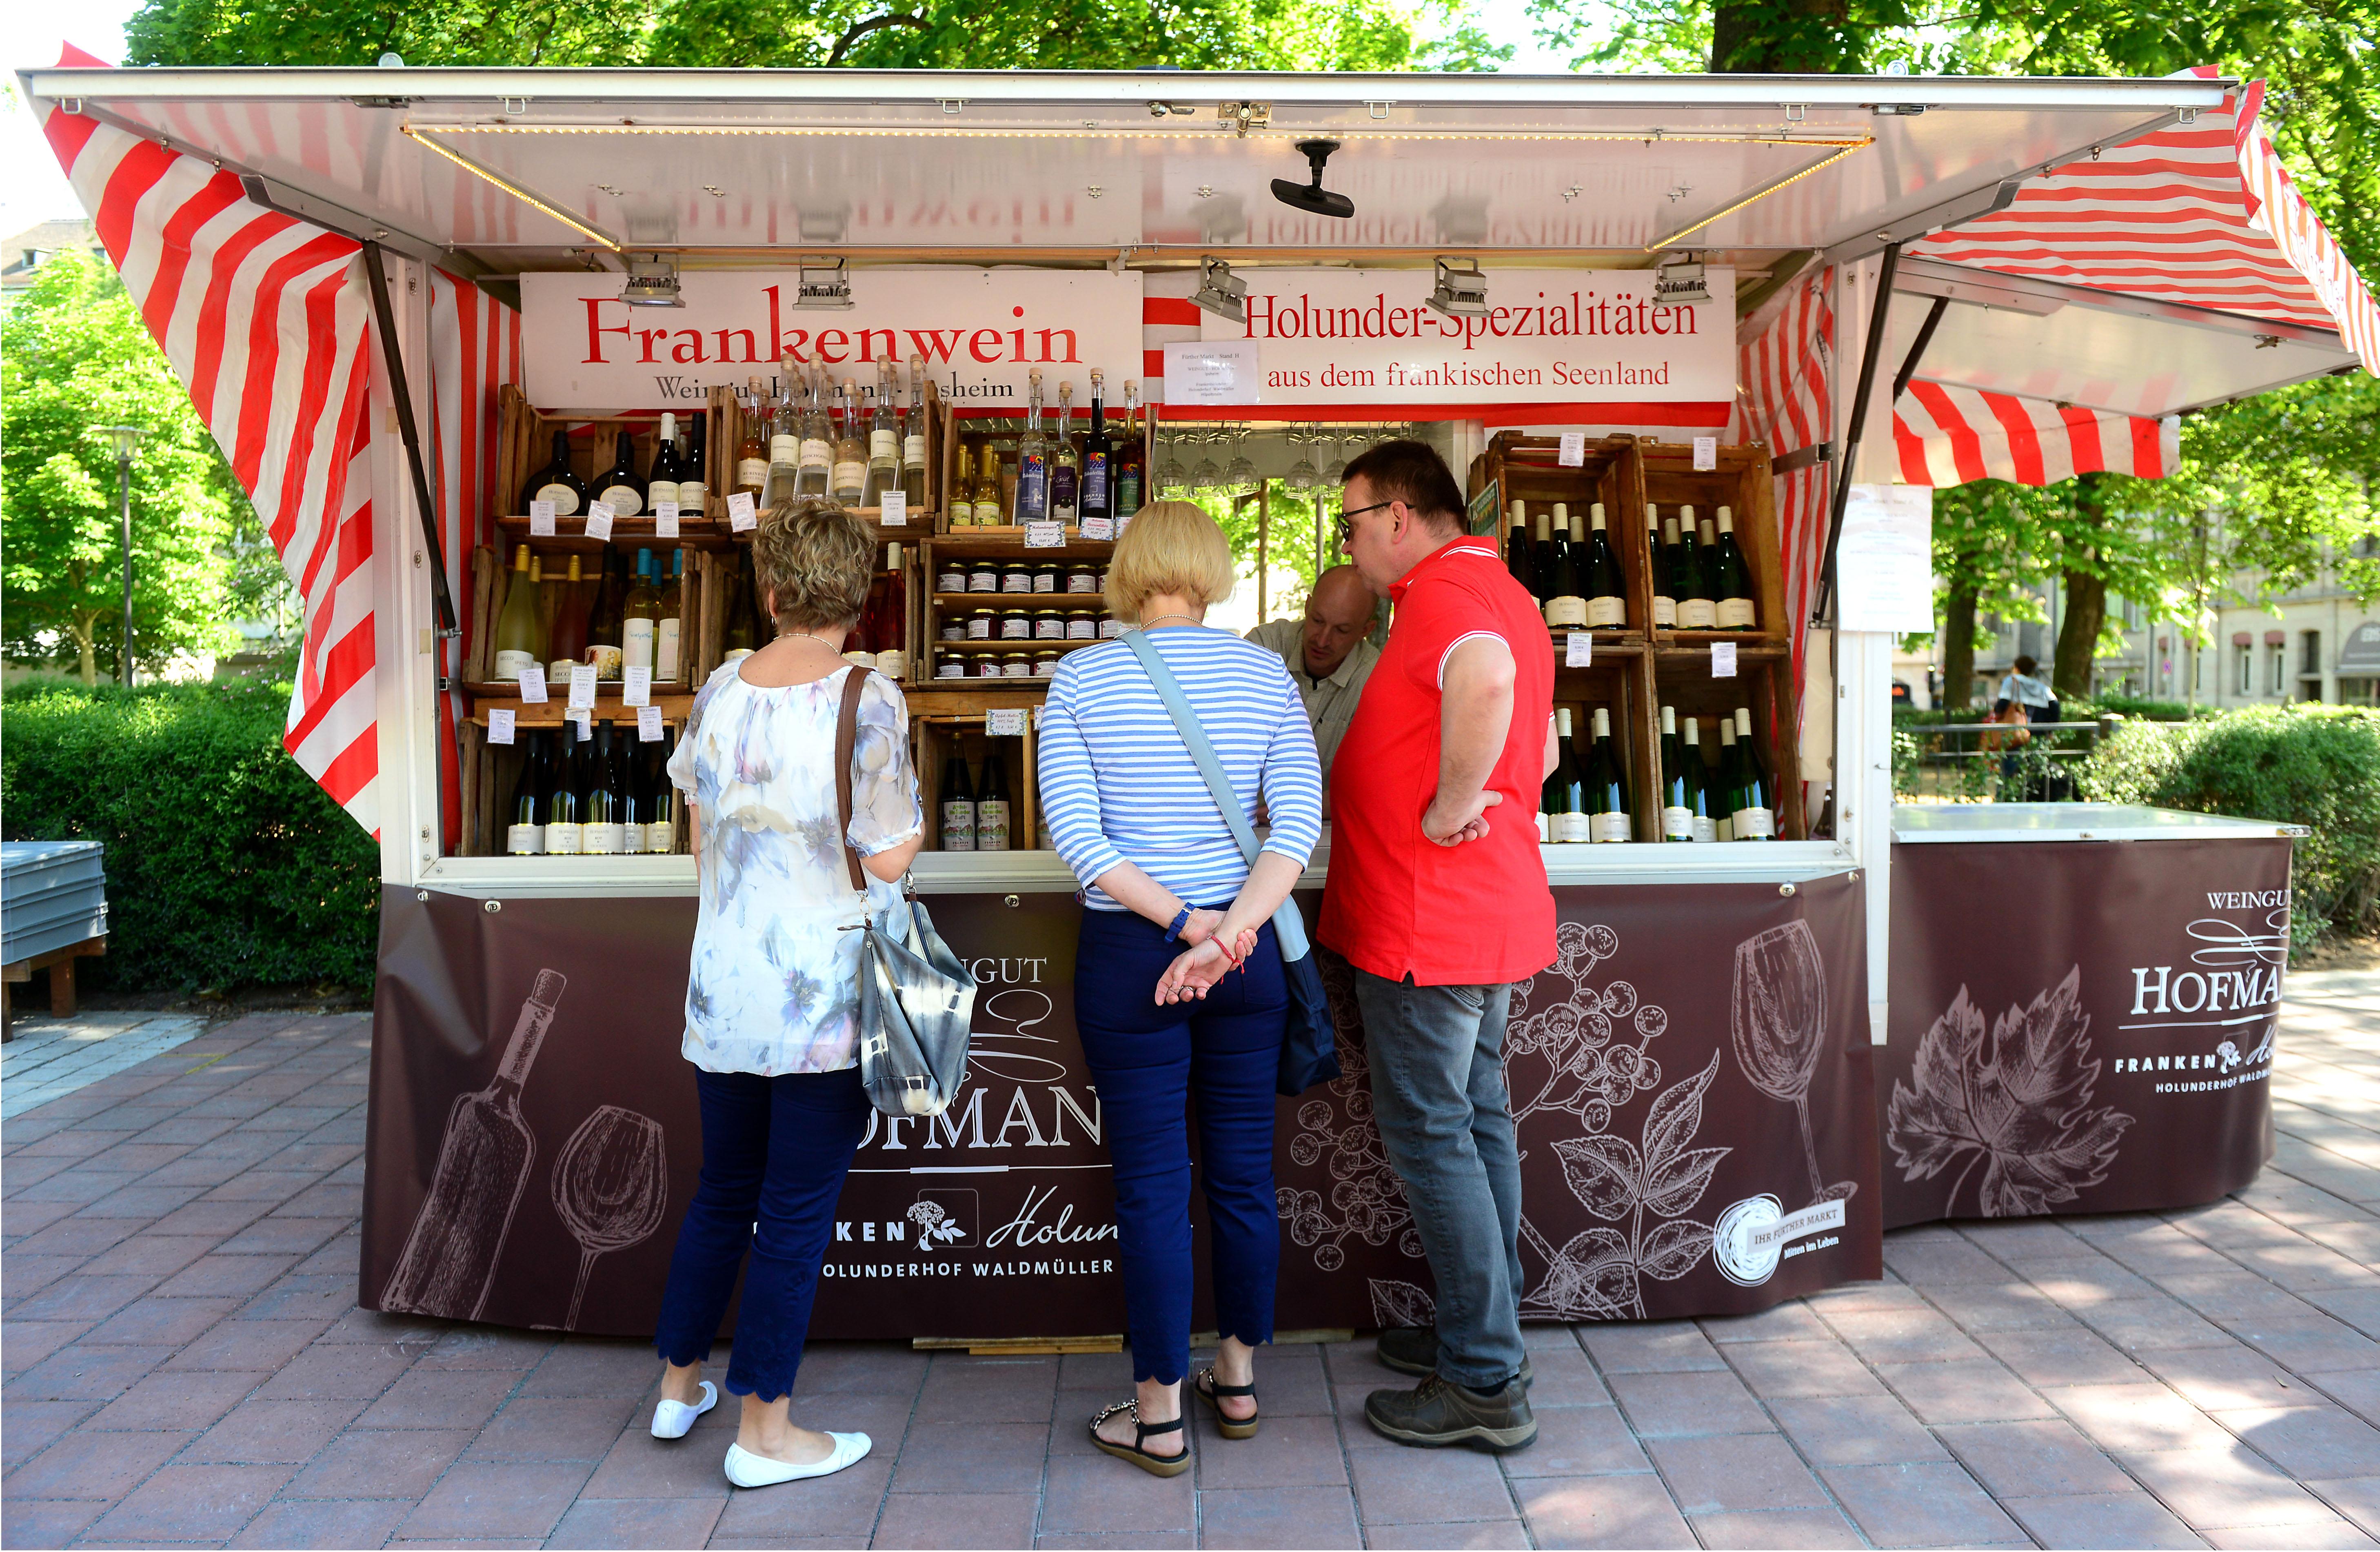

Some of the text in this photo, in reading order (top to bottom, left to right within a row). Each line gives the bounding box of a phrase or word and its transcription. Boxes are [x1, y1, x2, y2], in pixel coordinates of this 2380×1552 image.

[579, 285, 1083, 364] Frankenwein
[1243, 291, 1698, 350] Holunder-Spezialitäten
[937, 371, 1015, 397] sheim
[1268, 361, 1669, 387] aus dem fränkischen Seenland
[2130, 966, 2284, 1014] HOFMA
[2115, 1054, 2216, 1073] FRANKEN
[2156, 1078, 2237, 1093] HOLUNDERHOF
[857, 1086, 1100, 1150] FMAN
[986, 1185, 1117, 1247] Holun
[1755, 1234, 1771, 1245] IHR
[1807, 1210, 1838, 1225] MARKT
[1805, 1241, 1816, 1252] im
[1817, 1235, 1839, 1250] Leben
[823, 1258, 1113, 1278] OLUNDERHOF WALDMÜLLER
